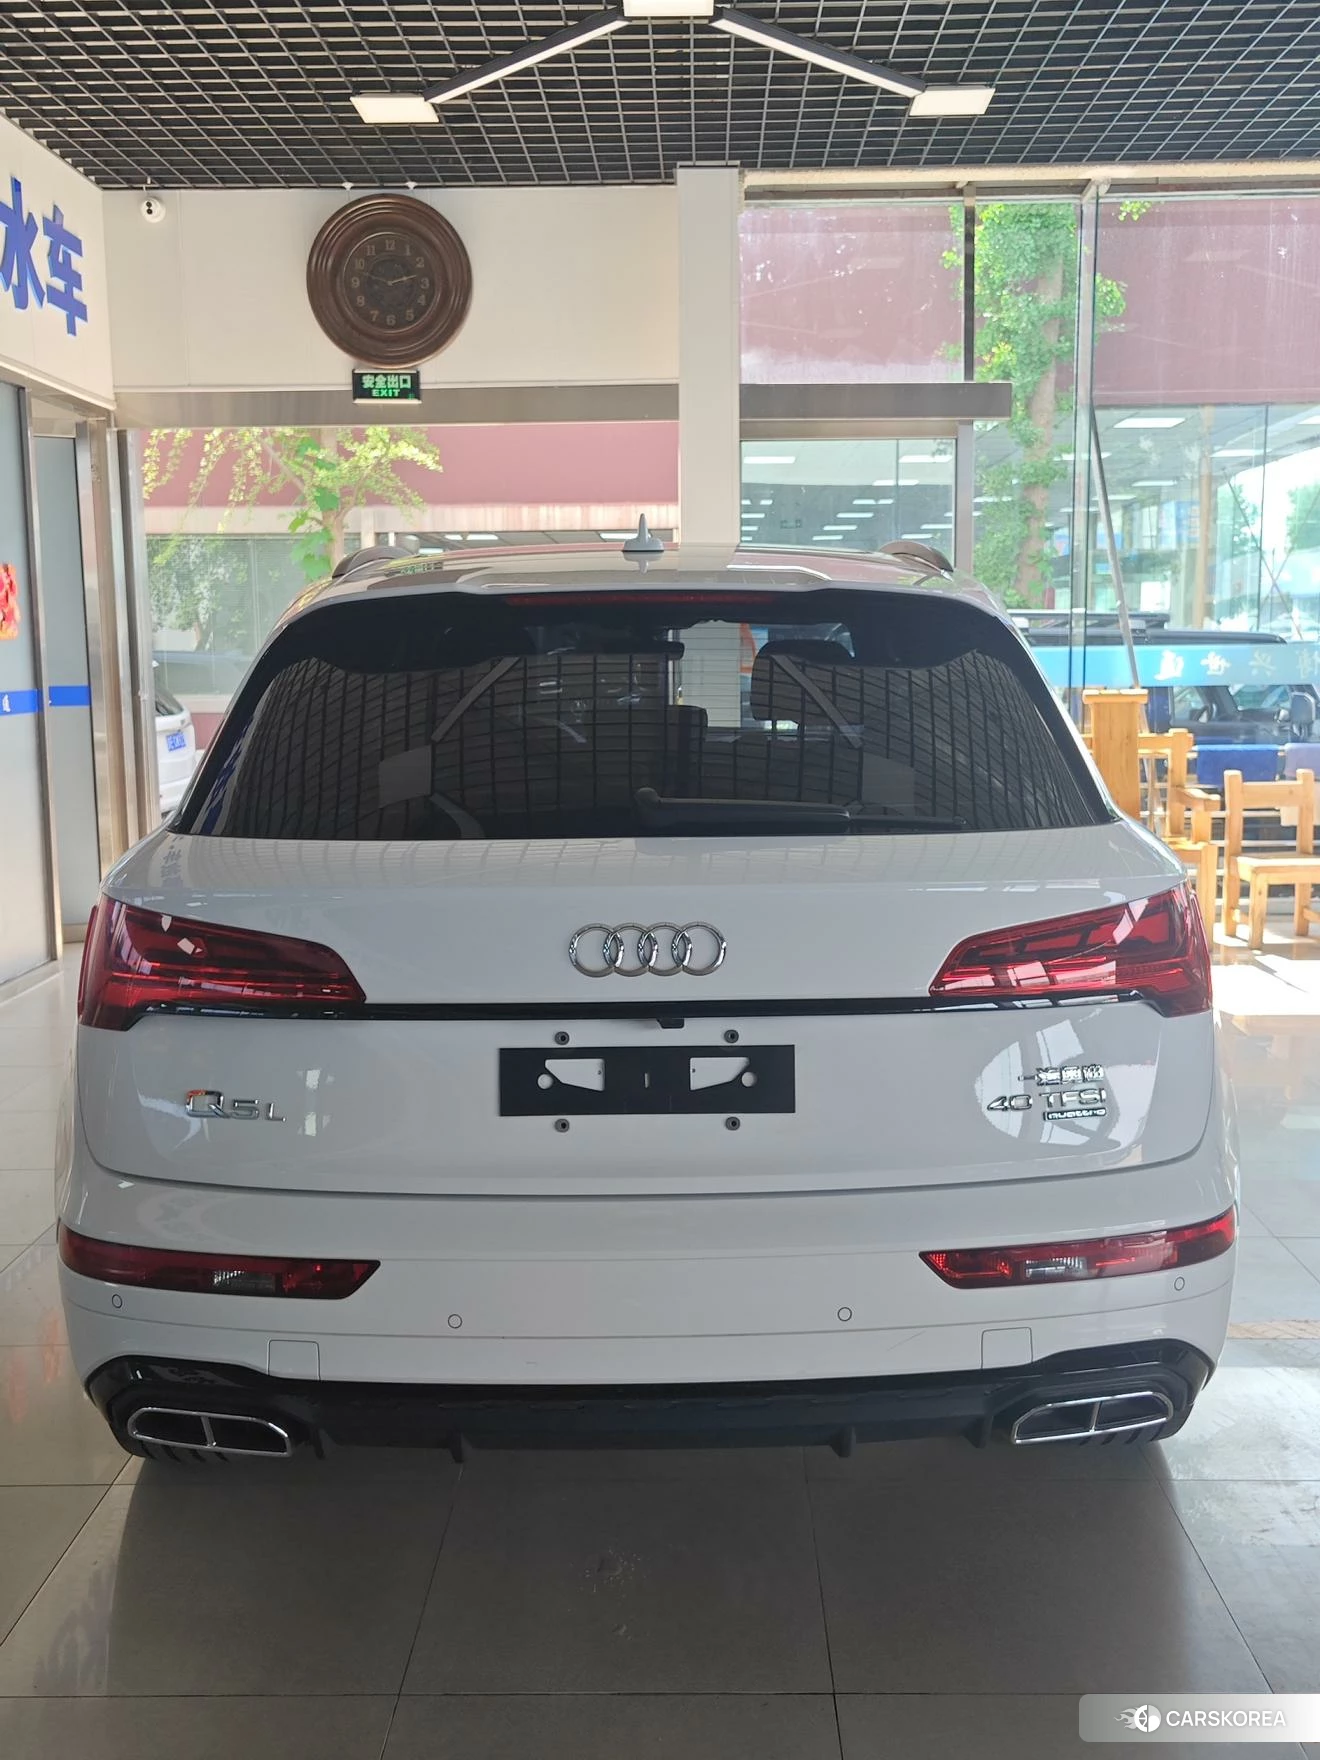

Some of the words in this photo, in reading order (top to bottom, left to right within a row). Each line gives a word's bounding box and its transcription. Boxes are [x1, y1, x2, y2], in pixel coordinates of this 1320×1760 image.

[0, 175, 88, 337] 水车
[362, 374, 412, 389] 安全出口
[372, 389, 401, 397] EXIT
[987, 1095, 1033, 1111] 40
[1039, 1088, 1106, 1108] TFSI
[1043, 1108, 1106, 1120] quattro
